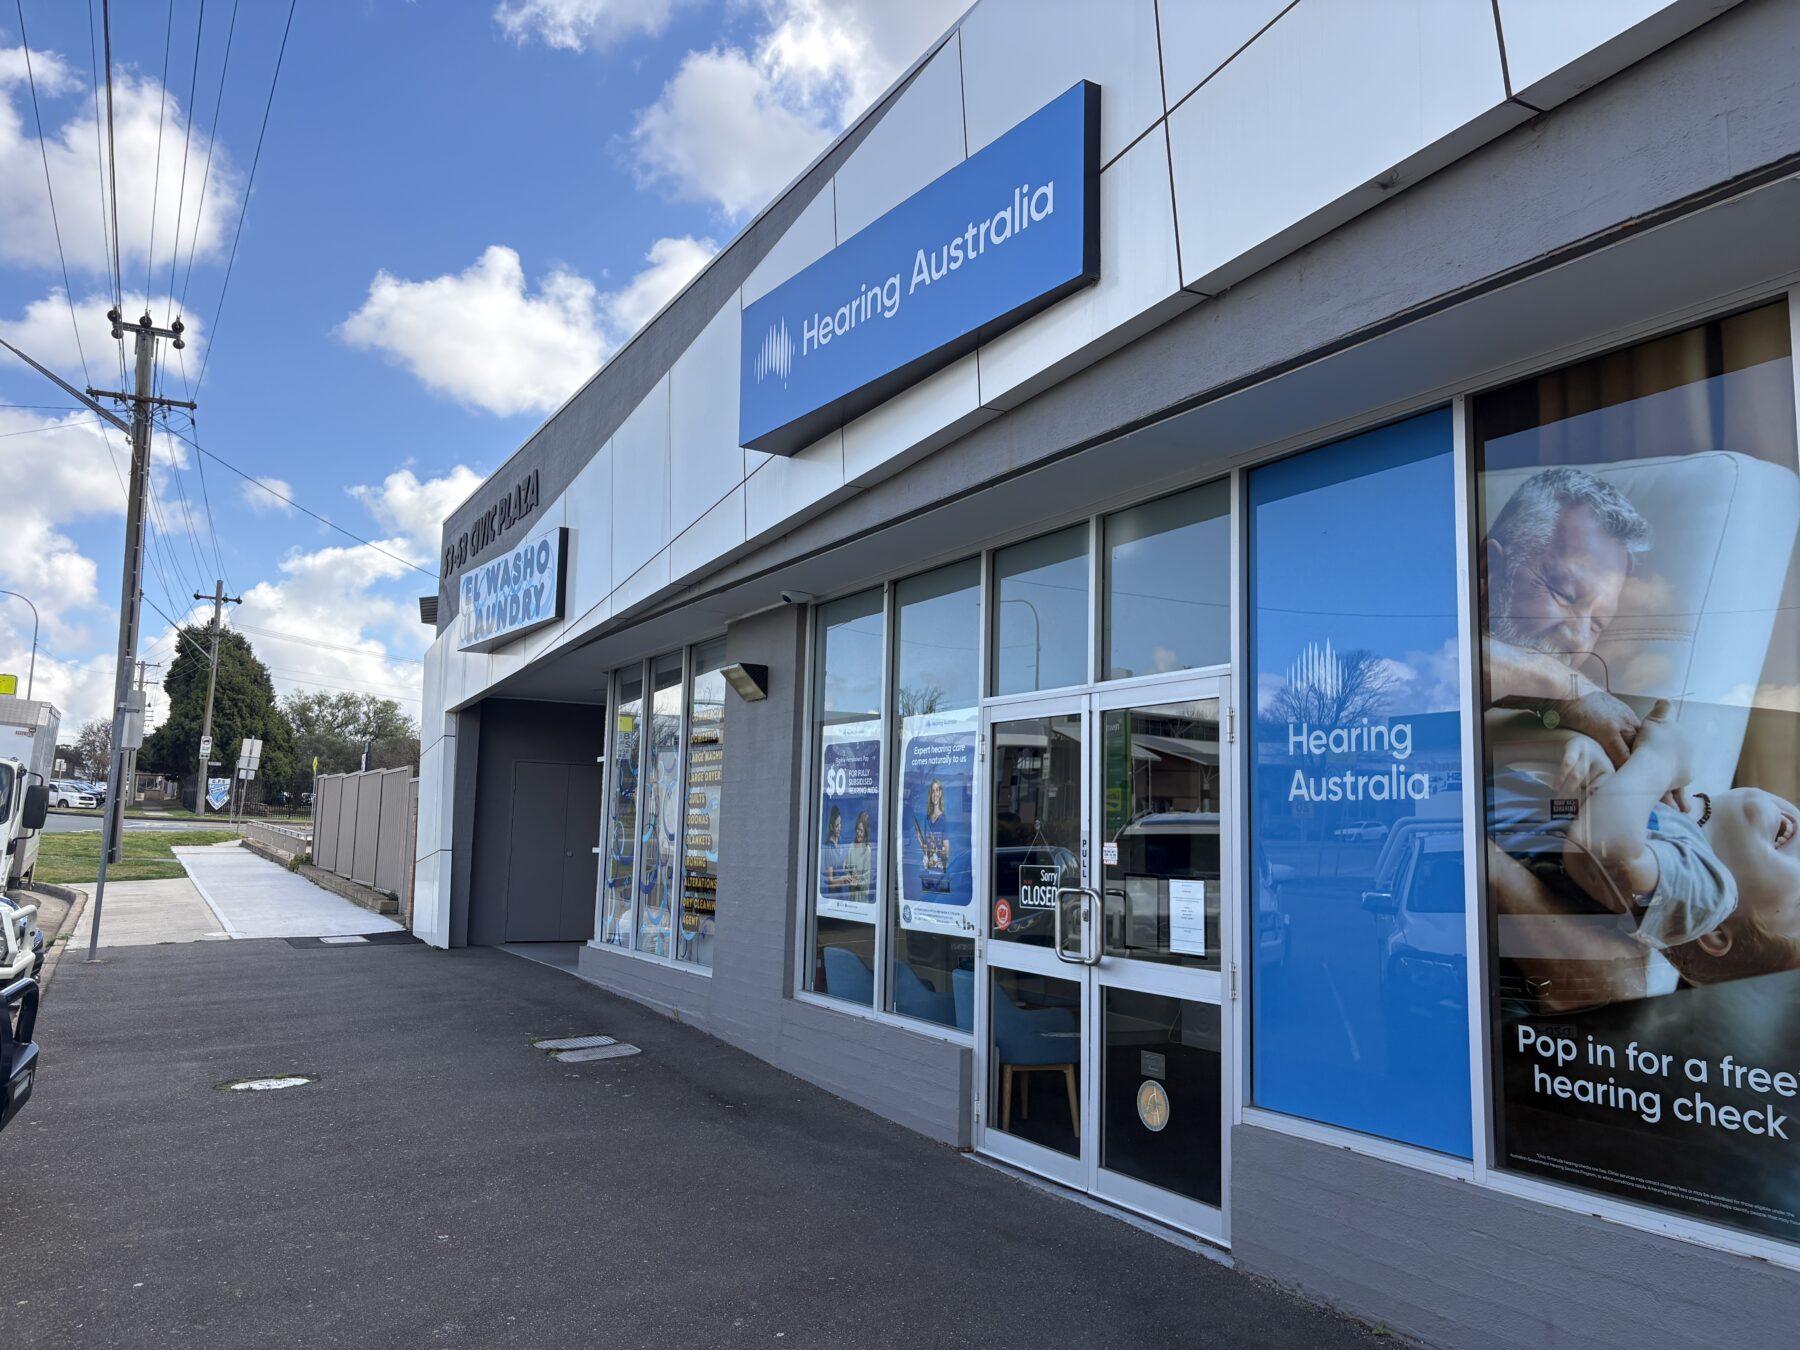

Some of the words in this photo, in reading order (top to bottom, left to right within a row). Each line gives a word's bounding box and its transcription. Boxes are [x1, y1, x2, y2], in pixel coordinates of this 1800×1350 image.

[803, 273, 900, 356] Hearing
[909, 181, 1054, 295] Australia
[471, 504, 497, 557] CIVIC
[498, 468, 539, 536] PLAZA
[465, 573, 481, 604] EL
[485, 539, 550, 597] WASHO
[466, 582, 544, 642] LAUNDRY
[1288, 717, 1412, 760] Hearing
[704, 750, 723, 762] MACHI
[914, 746, 930, 756] Expert
[931, 744, 952, 754] hearing
[952, 744, 966, 752] care
[928, 755, 952, 766] naturally
[848, 778, 872, 786] SUBSIDISED
[1288, 764, 1430, 802] Australia
[688, 794, 705, 804] QUILTS
[688, 814, 708, 824] DOONAS
[686, 836, 711, 846] BLANKETS
[684, 856, 706, 868] IRONING
[684, 878, 717, 889] ALTERATIONS
[1040, 869, 1058, 885] Sorry
[1021, 885, 1058, 906] CLOSED
[682, 898, 692, 907] DRY
[693, 898, 716, 911] CLEANIN
[682, 914, 698, 926] AGENT
[1518, 1024, 1577, 1067] Pop
[1587, 1035, 1616, 1068] in
[1626, 1041, 1673, 1077] for
[1684, 1058, 1708, 1083] a
[1720, 1056, 1800, 1097] free
[1534, 1064, 1661, 1123] hearing
[1673, 1092, 1789, 1140] check
